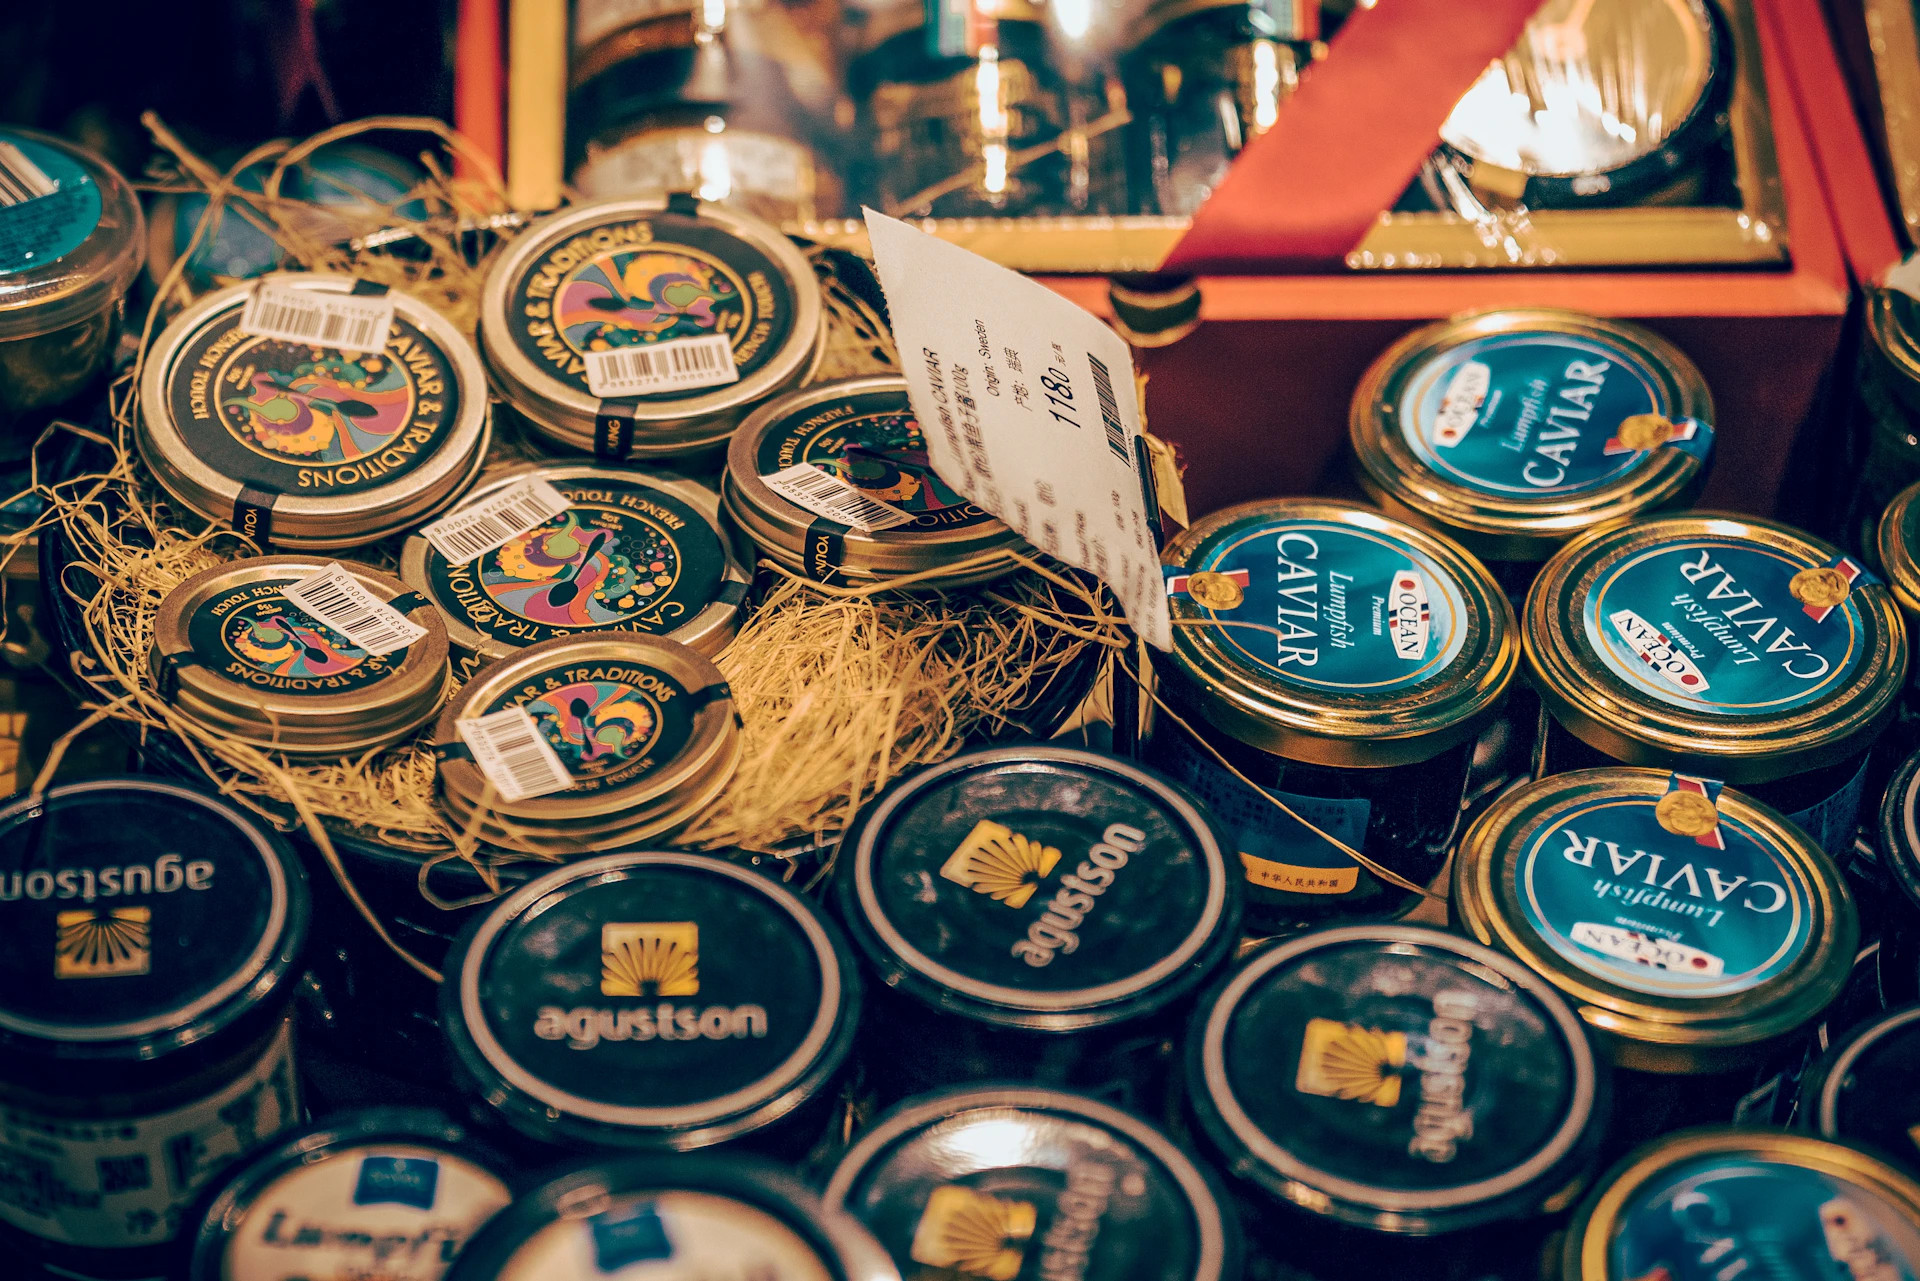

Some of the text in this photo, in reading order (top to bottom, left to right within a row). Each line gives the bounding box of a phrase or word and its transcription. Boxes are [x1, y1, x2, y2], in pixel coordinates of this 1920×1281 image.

[525, 221, 655, 298] TRADITIONS
[922, 346, 949, 404] CAVIAR
[975, 318, 1001, 398] Origin: Sweden
[189, 367, 211, 421] TOUCH
[417, 398, 443, 419] &
[1500, 377, 1550, 453] Lumpfish
[1522, 358, 1611, 488] CAVIAR
[297, 422, 438, 489] TRADITIONS
[620, 491, 686, 531] FRENCH
[781, 485, 821, 508] 053276
[432, 512, 477, 536] 200016
[210, 591, 250, 617] TOUCH
[334, 574, 370, 605] 100019
[1276, 532, 1320, 667] CAVIAR
[1322, 570, 1356, 649] Lumpfish
[374, 606, 412, 636] 053276
[1371, 595, 1385, 636] Premium
[1398, 593, 1419, 658] OCEAN
[1670, 593, 1761, 666] Lumpfish
[1679, 550, 1830, 680] CAVIAR
[1618, 615, 1686, 675] OCEAN
[1660, 621, 1707, 661] Premium
[225, 661, 352, 690] TRADITIONS
[352, 667, 367, 679] &
[543, 677, 562, 689] &
[564, 666, 677, 704] TRADITIONS
[0, 853, 216, 903] agustson
[1010, 822, 1146, 968] agustson
[1260, 869, 1339, 890] 中华人民共和国
[1561, 828, 1788, 915] CAVIAR
[1593, 879, 1726, 928] Lumpfish
[1581, 926, 1688, 967] OCEAN
[533, 1003, 769, 1051] agustson
